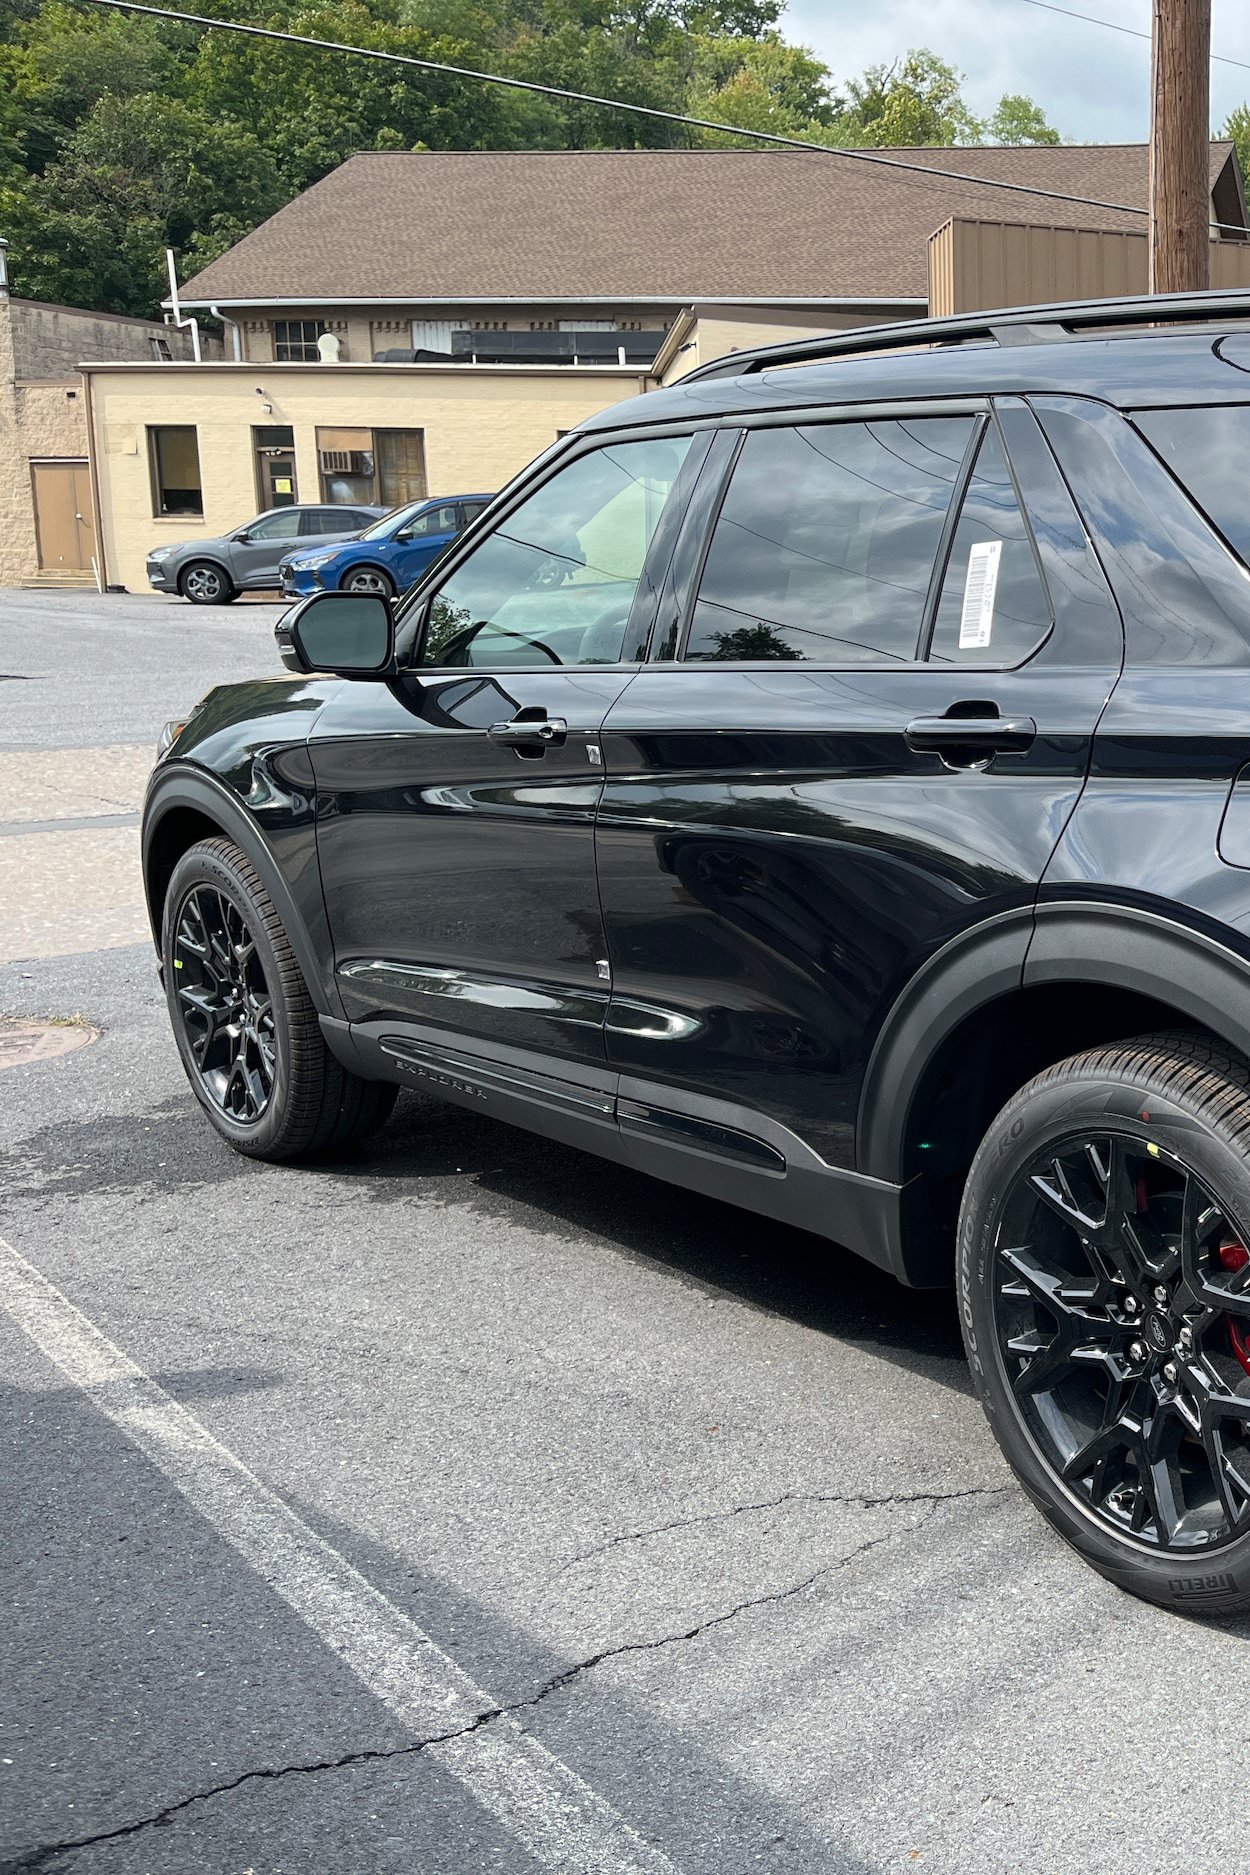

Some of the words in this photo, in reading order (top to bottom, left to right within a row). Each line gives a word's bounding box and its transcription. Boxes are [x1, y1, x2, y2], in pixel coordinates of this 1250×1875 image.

[394, 1060, 488, 1100] EXPLORER
[961, 1192, 985, 1377] SCORPION
[1168, 1573, 1241, 1600] PIRELLI
